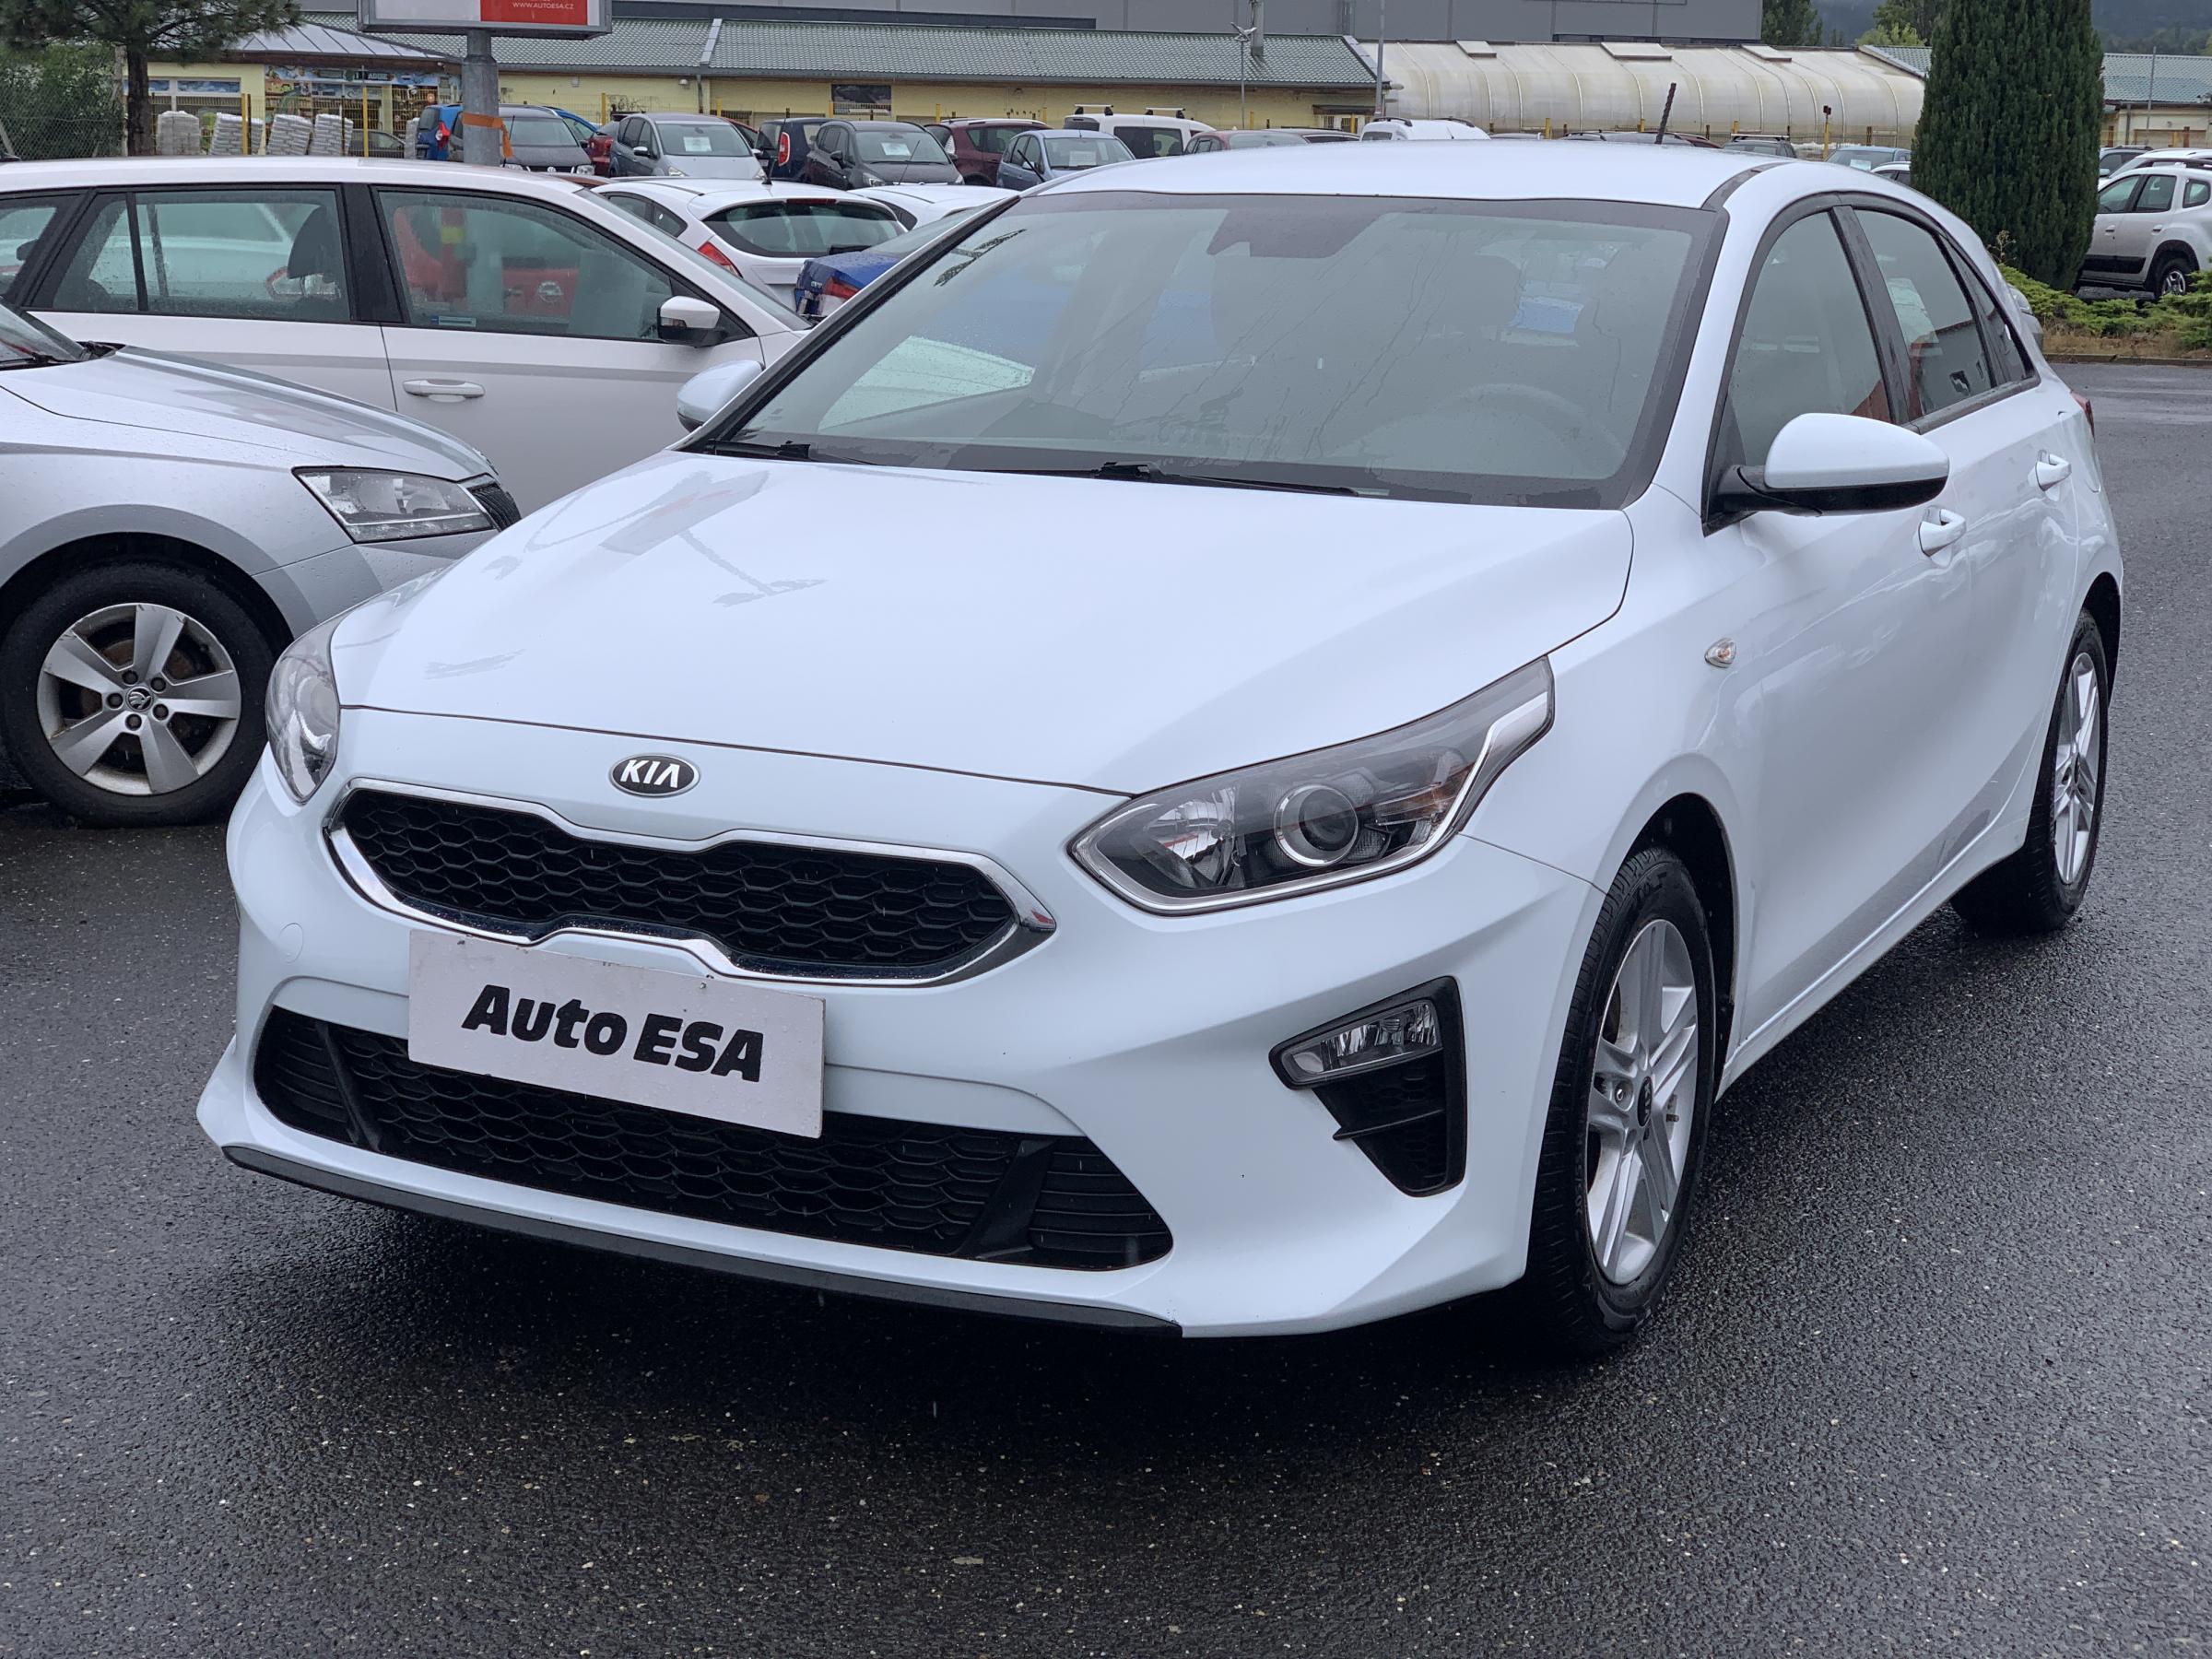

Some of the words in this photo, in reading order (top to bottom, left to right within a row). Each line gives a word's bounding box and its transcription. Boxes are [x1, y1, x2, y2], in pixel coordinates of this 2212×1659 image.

[619, 759, 680, 789] KIA
[461, 984, 628, 1056] Auto
[633, 1013, 764, 1083] ESA
